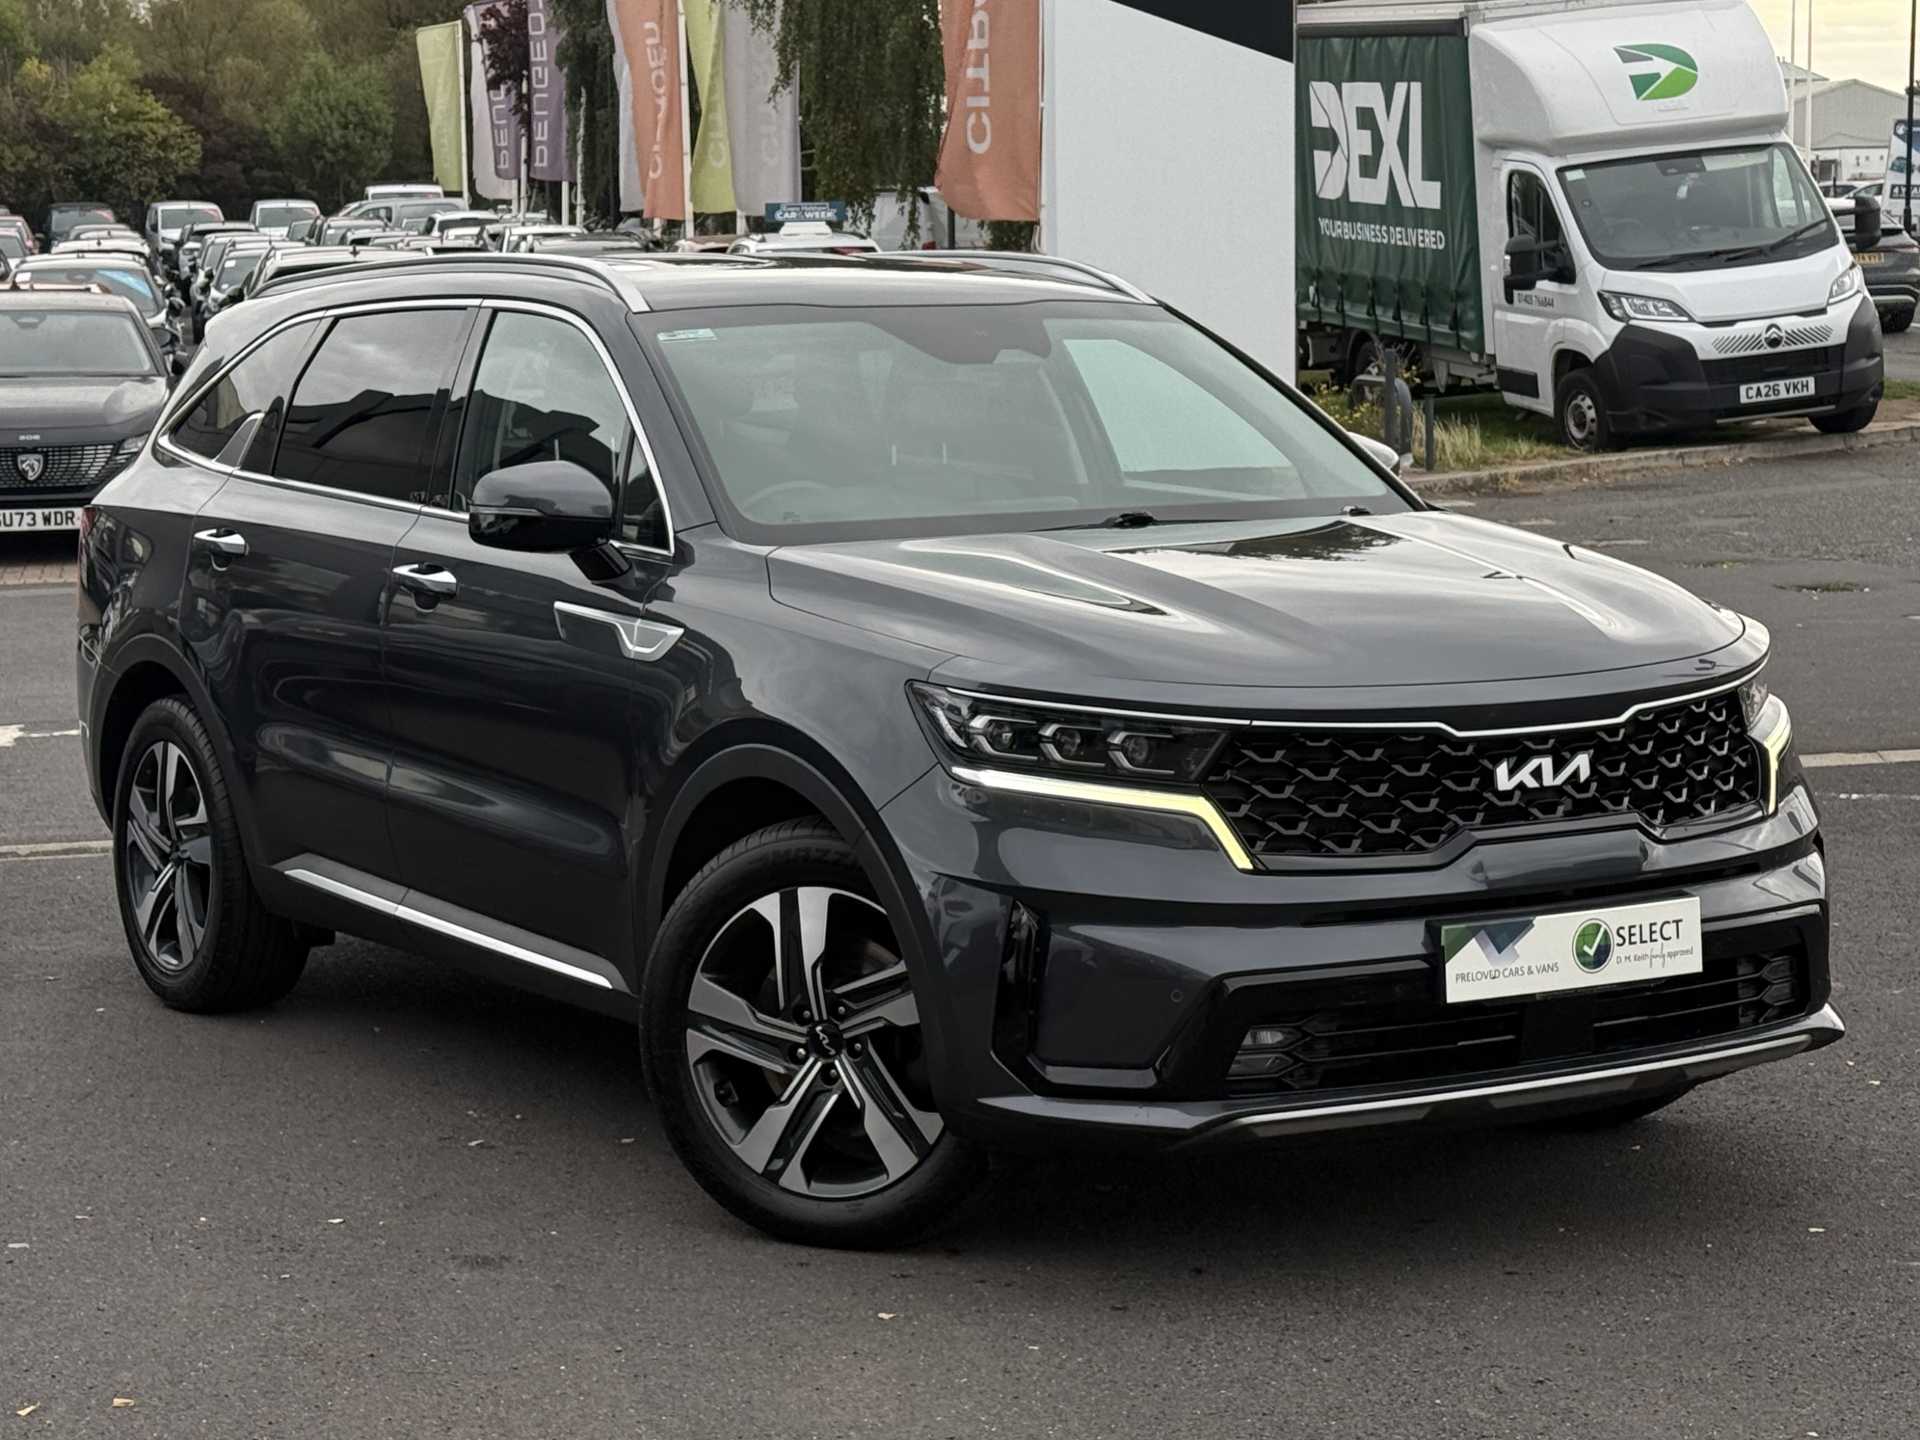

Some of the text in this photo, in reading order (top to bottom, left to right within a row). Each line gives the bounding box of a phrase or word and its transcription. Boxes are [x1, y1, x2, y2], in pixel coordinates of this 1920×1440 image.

[1309, 80, 1442, 210] DEXL
[1318, 216, 1446, 250] YOUR BUSINESS DELIVERED
[1745, 379, 1810, 400] CA26 VKH
[0, 510, 76, 528] U73 WDR
[1495, 753, 1592, 792] KIA
[1615, 919, 1684, 947] SELECT
[1455, 962, 1560, 984] PRELOVED CARS & VANS
